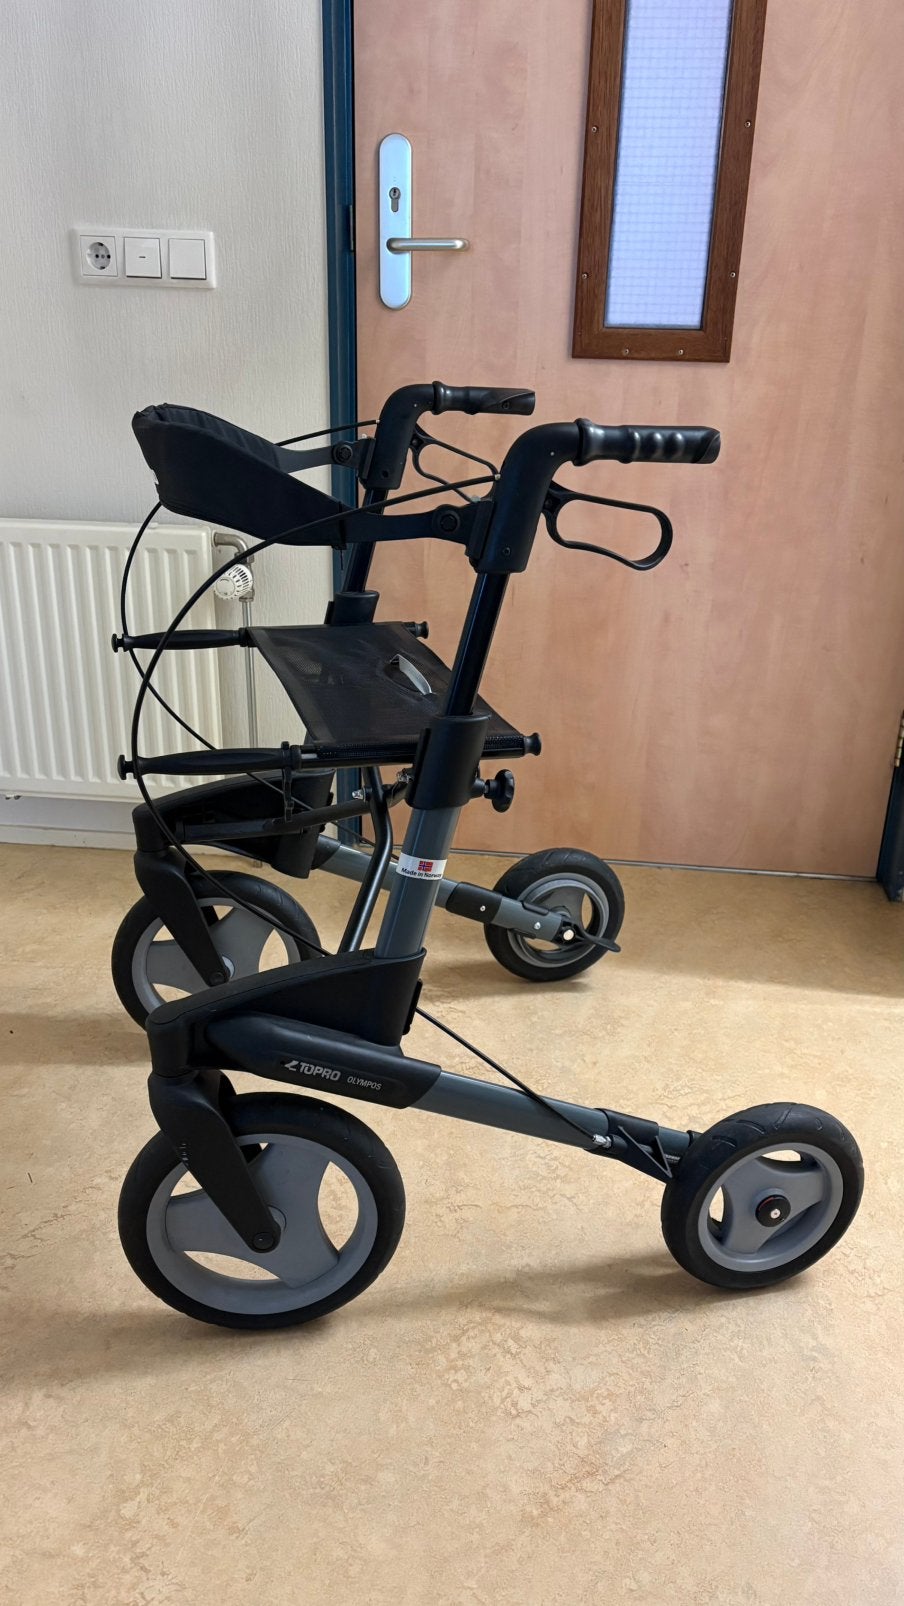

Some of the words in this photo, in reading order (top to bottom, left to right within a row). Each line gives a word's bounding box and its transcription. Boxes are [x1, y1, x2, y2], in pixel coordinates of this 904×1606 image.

[401, 868, 417, 876] Made
[299, 1062, 341, 1081] TOPRO
[347, 1076, 382, 1091] OLYMPOS
